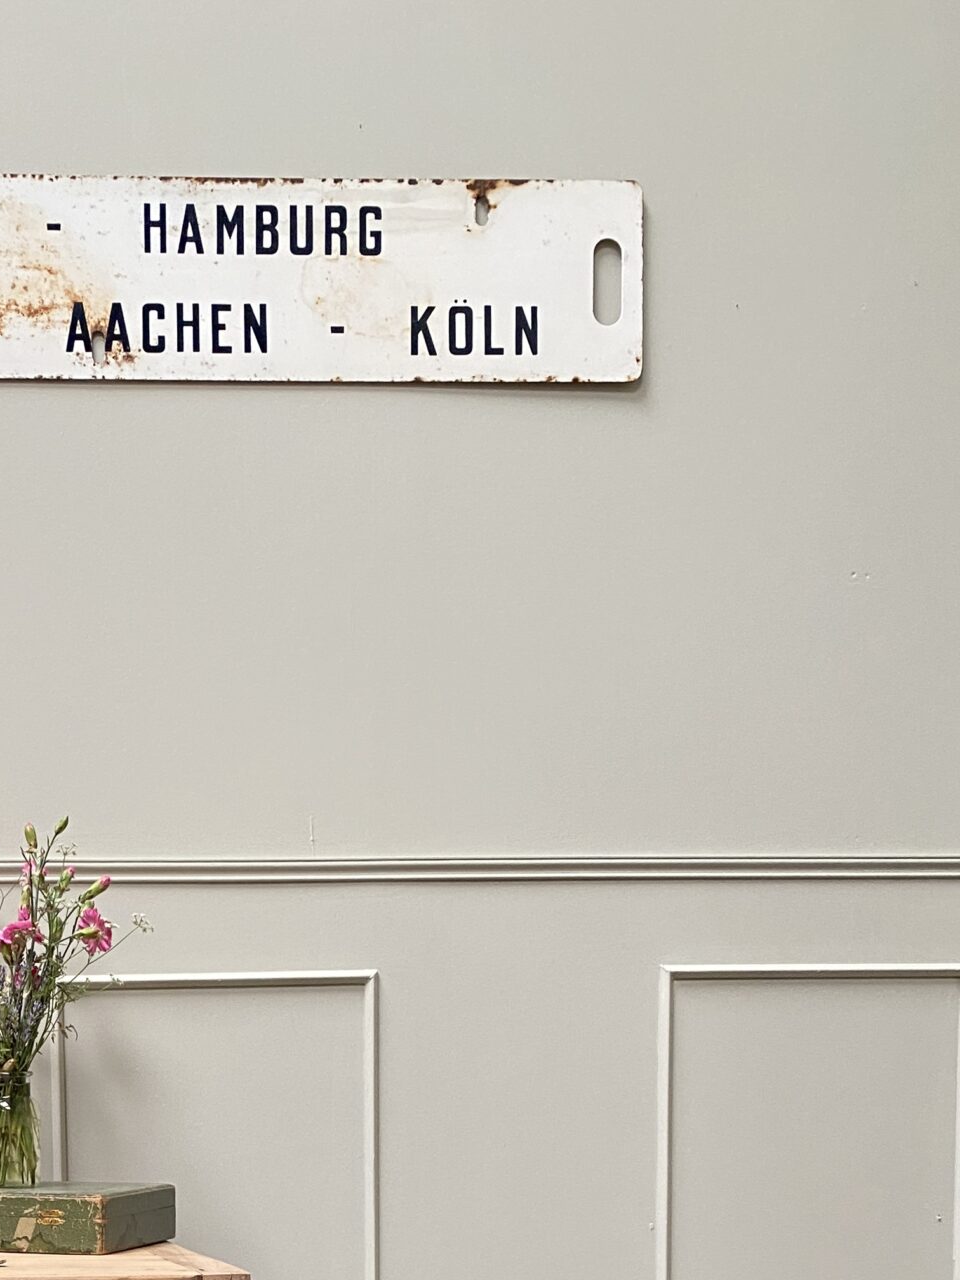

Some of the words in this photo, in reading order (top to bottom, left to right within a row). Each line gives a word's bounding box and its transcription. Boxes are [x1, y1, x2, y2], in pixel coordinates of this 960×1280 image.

[142, 202, 384, 256] HAMBURG
[65, 302, 269, 354] AACHEN
[410, 298, 539, 356] KÖLN
